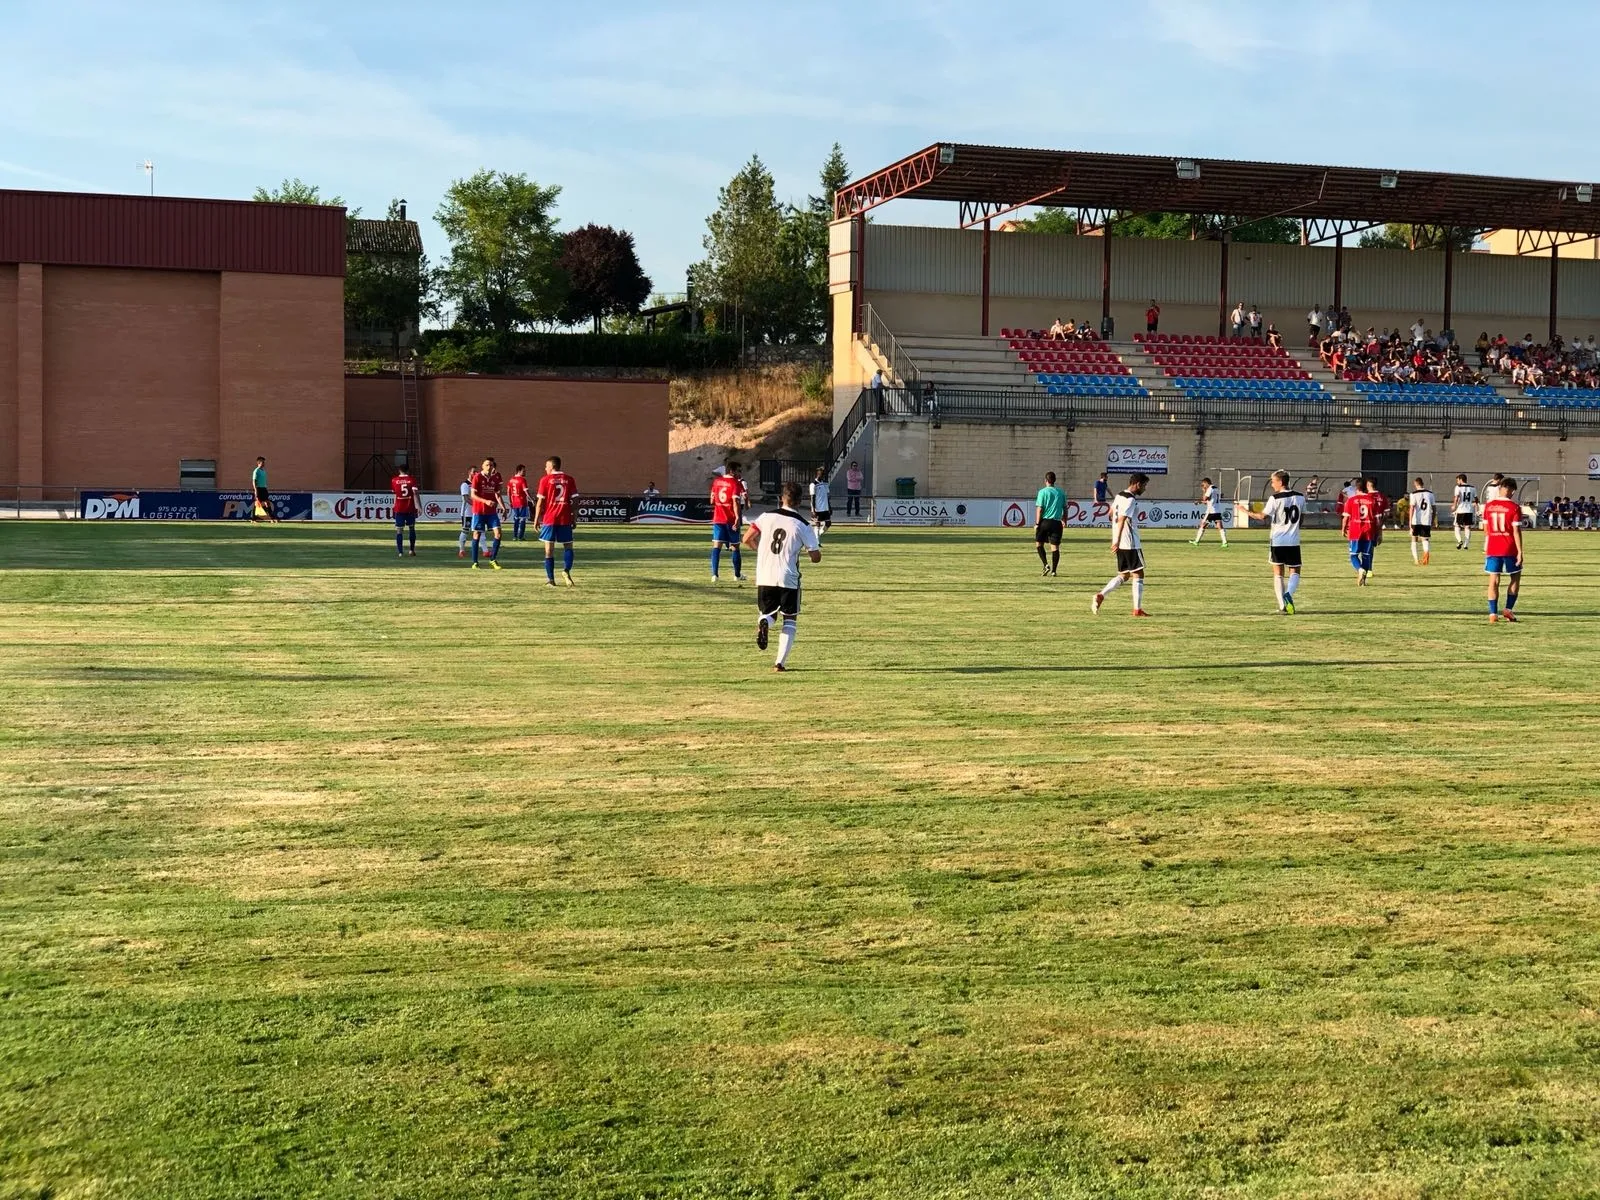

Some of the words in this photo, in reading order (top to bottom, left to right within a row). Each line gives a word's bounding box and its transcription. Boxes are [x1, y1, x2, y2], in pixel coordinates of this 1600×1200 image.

[1122, 448, 1136, 460] De
[1138, 448, 1166, 460] Pedro
[267, 494, 291, 502] eguros
[400, 484, 409, 497] 5
[555, 485, 565, 502] 2
[719, 487, 728, 503] 6
[1462, 491, 1471, 502] 14
[84, 498, 140, 519] DPM
[637, 500, 687, 512] Maheso
[1066, 501, 1088, 521] De
[1359, 504, 1369, 520] 9
[1420, 498, 1428, 511] 6
[1164, 510, 1188, 520] Soria
[1283, 504, 1299, 525] 10
[1490, 512, 1506, 532] 11
[770, 528, 787, 554] 8
